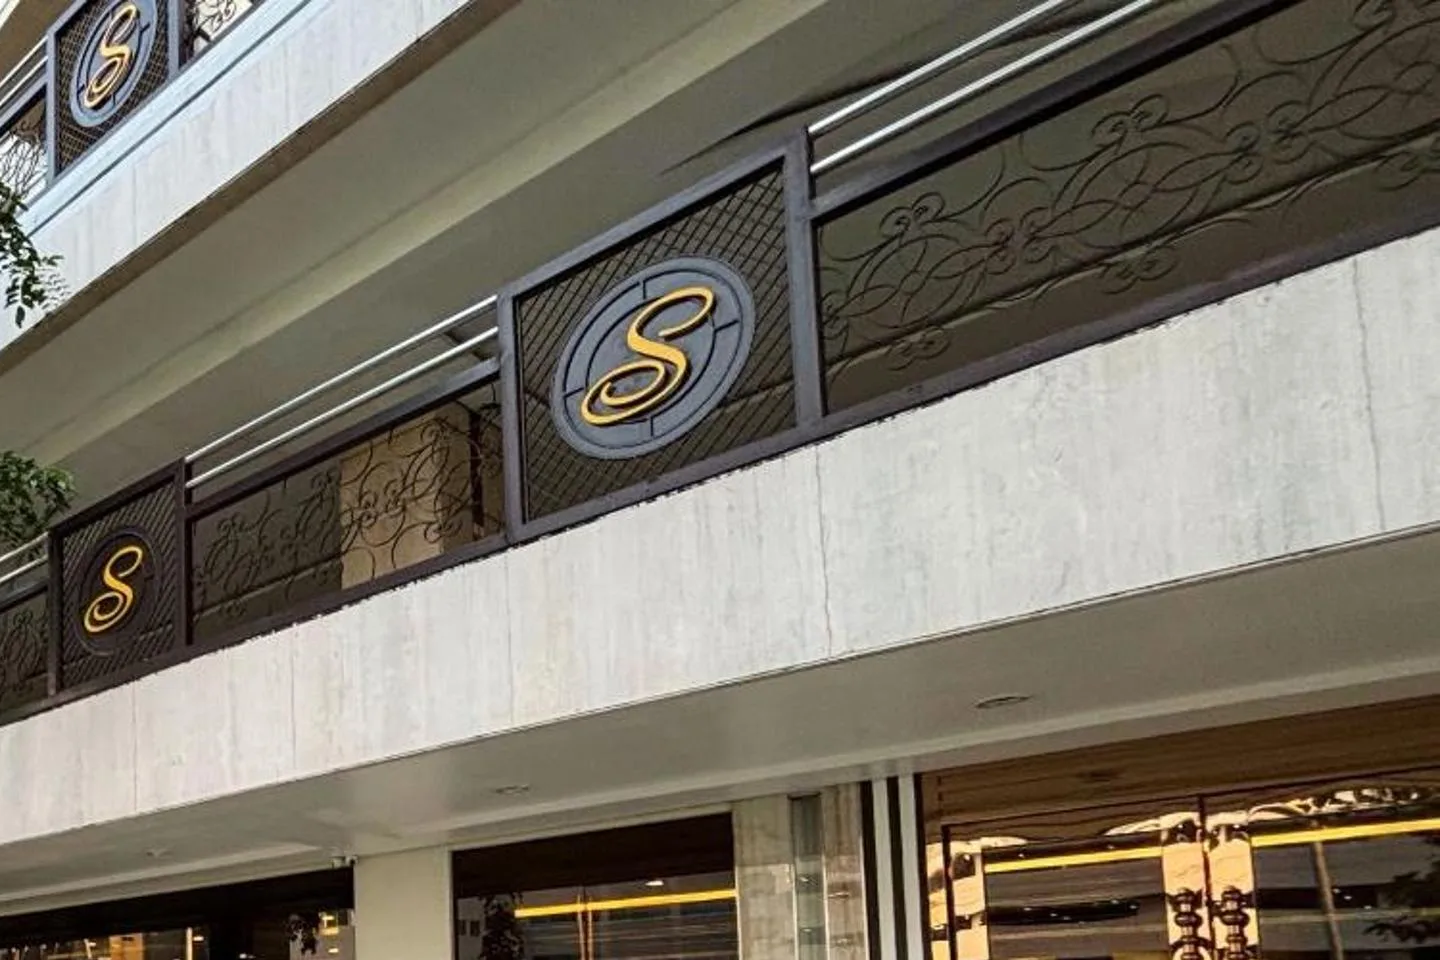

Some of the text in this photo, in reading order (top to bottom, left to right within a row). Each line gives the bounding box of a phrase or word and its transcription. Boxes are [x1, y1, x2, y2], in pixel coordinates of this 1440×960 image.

[83, 3, 137, 108] S
[580, 286, 715, 426] S
[83, 546, 143, 632] S
